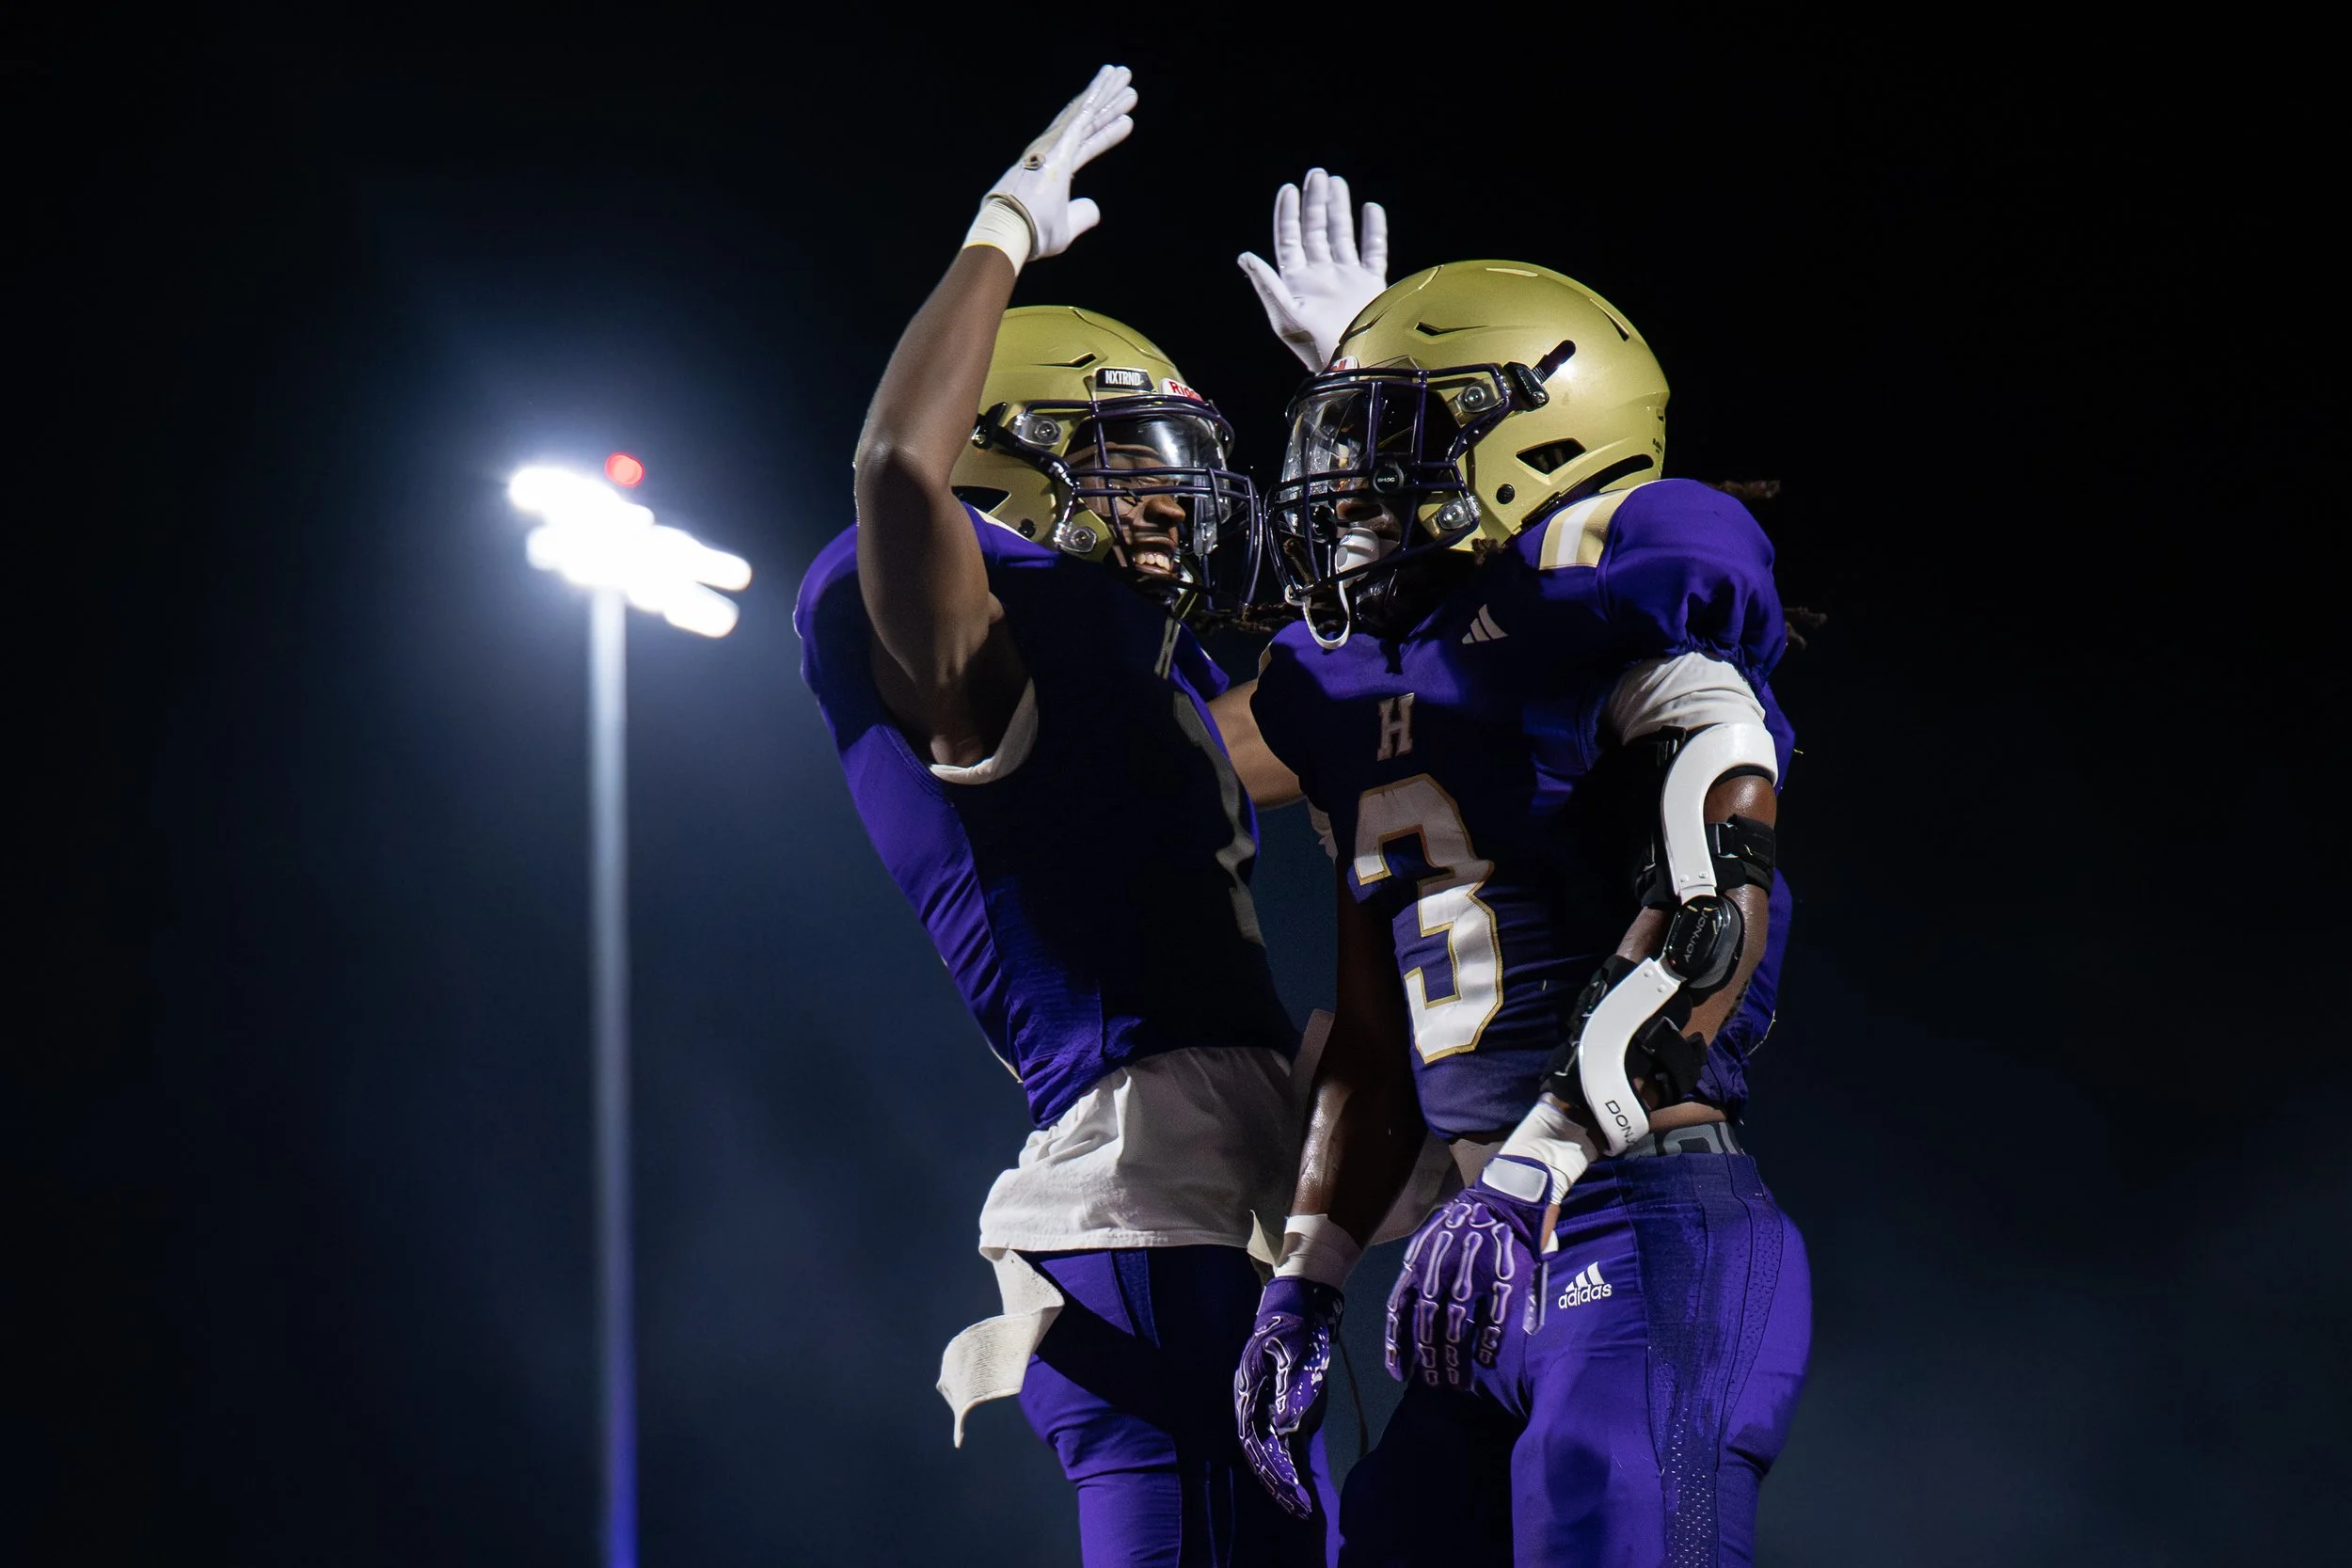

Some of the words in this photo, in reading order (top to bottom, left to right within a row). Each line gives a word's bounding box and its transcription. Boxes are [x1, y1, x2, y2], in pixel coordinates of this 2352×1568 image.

[1104, 370, 1141, 387] NXTRND
[1376, 692, 1415, 761] H
[1354, 773, 1503, 1065] 3
[1558, 1283, 1613, 1309] adidas
